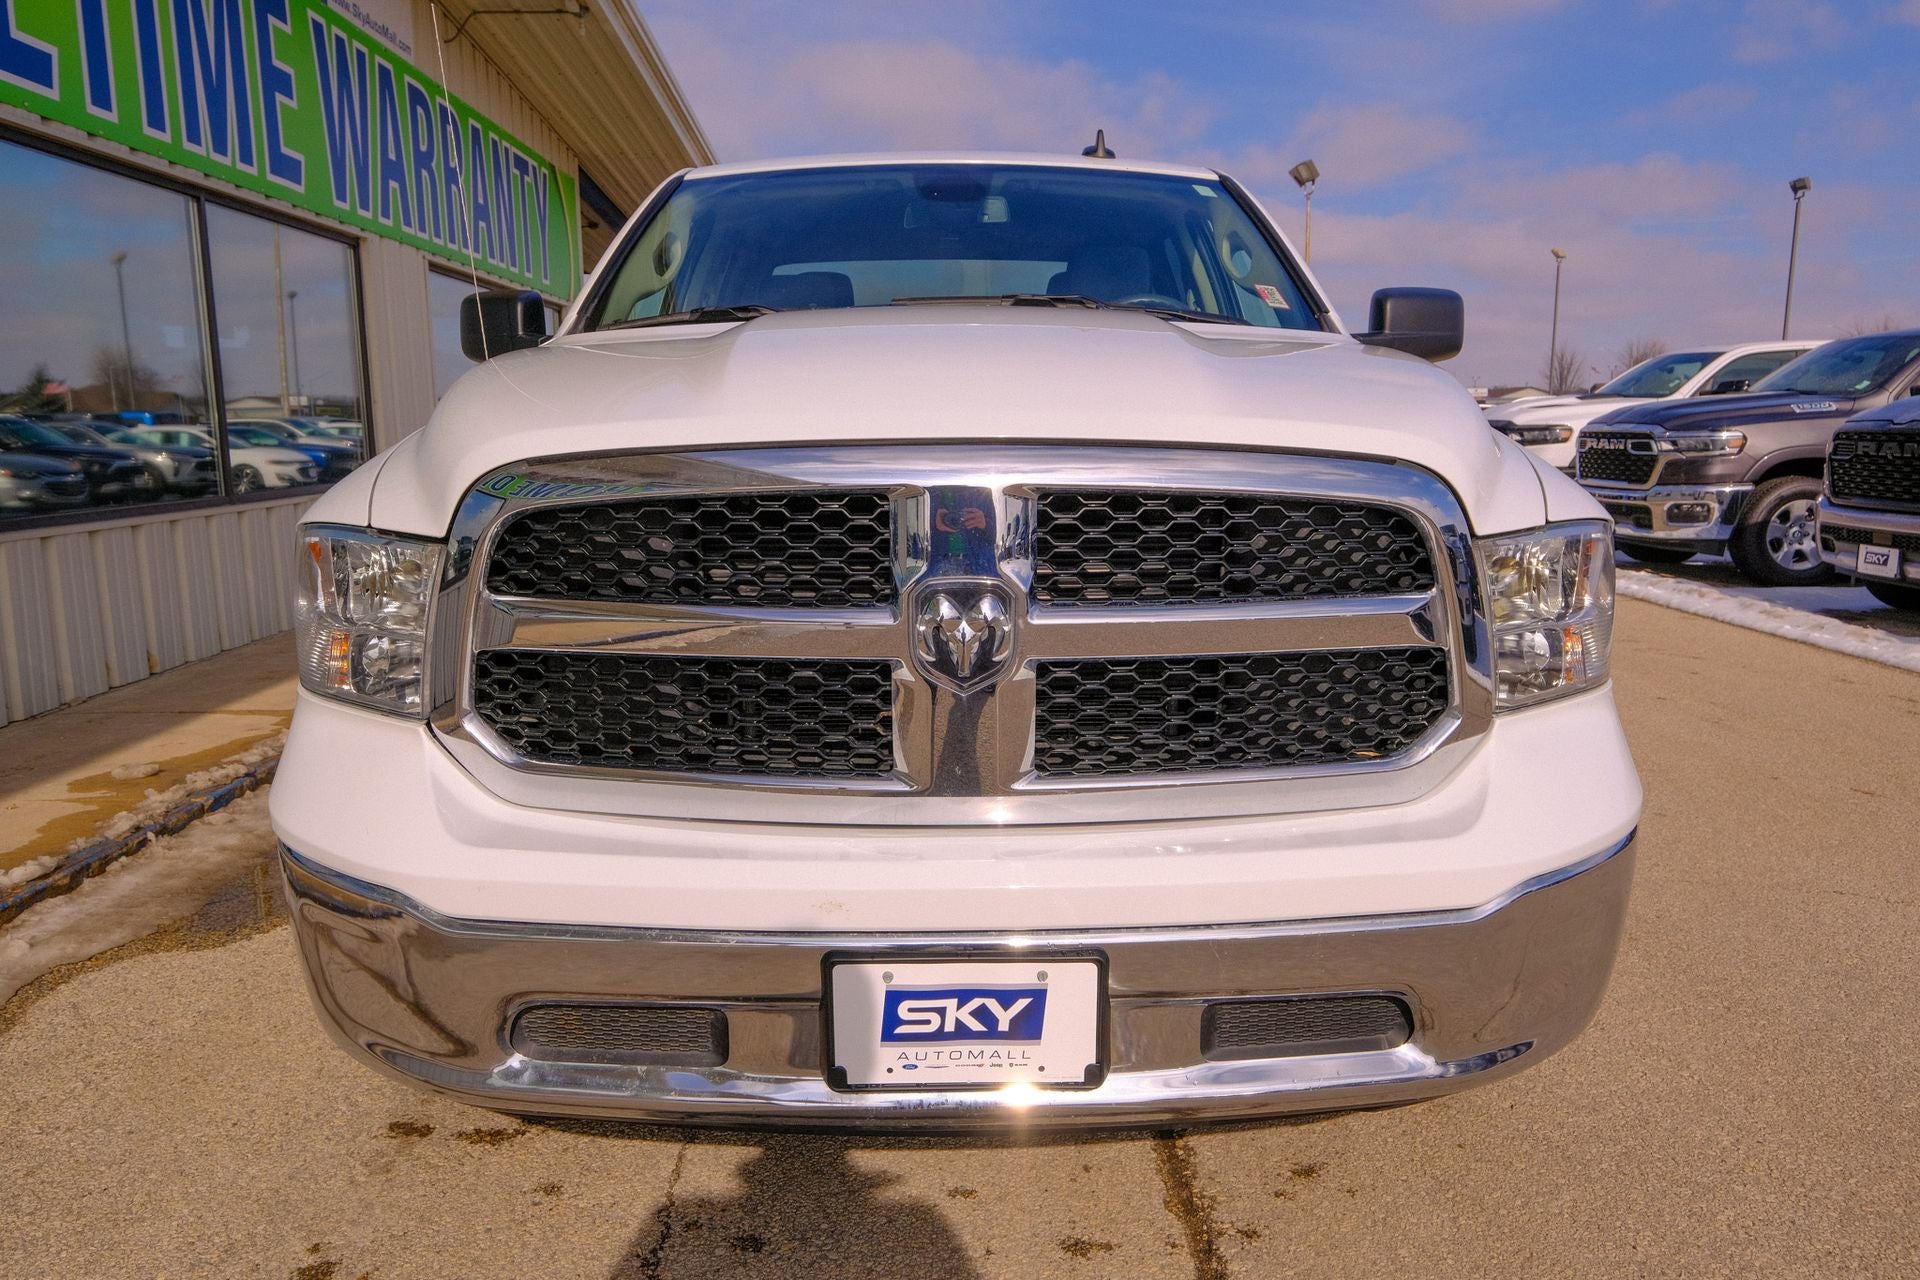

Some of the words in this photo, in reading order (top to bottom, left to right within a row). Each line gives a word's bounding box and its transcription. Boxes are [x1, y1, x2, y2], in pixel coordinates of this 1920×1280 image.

[307, 7, 551, 284] WARRANTY
[1587, 438, 1626, 450] RAM
[1865, 553, 1887, 565] SKY
[893, 997, 1034, 1034] SKY
[897, 1050, 1031, 1061] AUTOMALL
